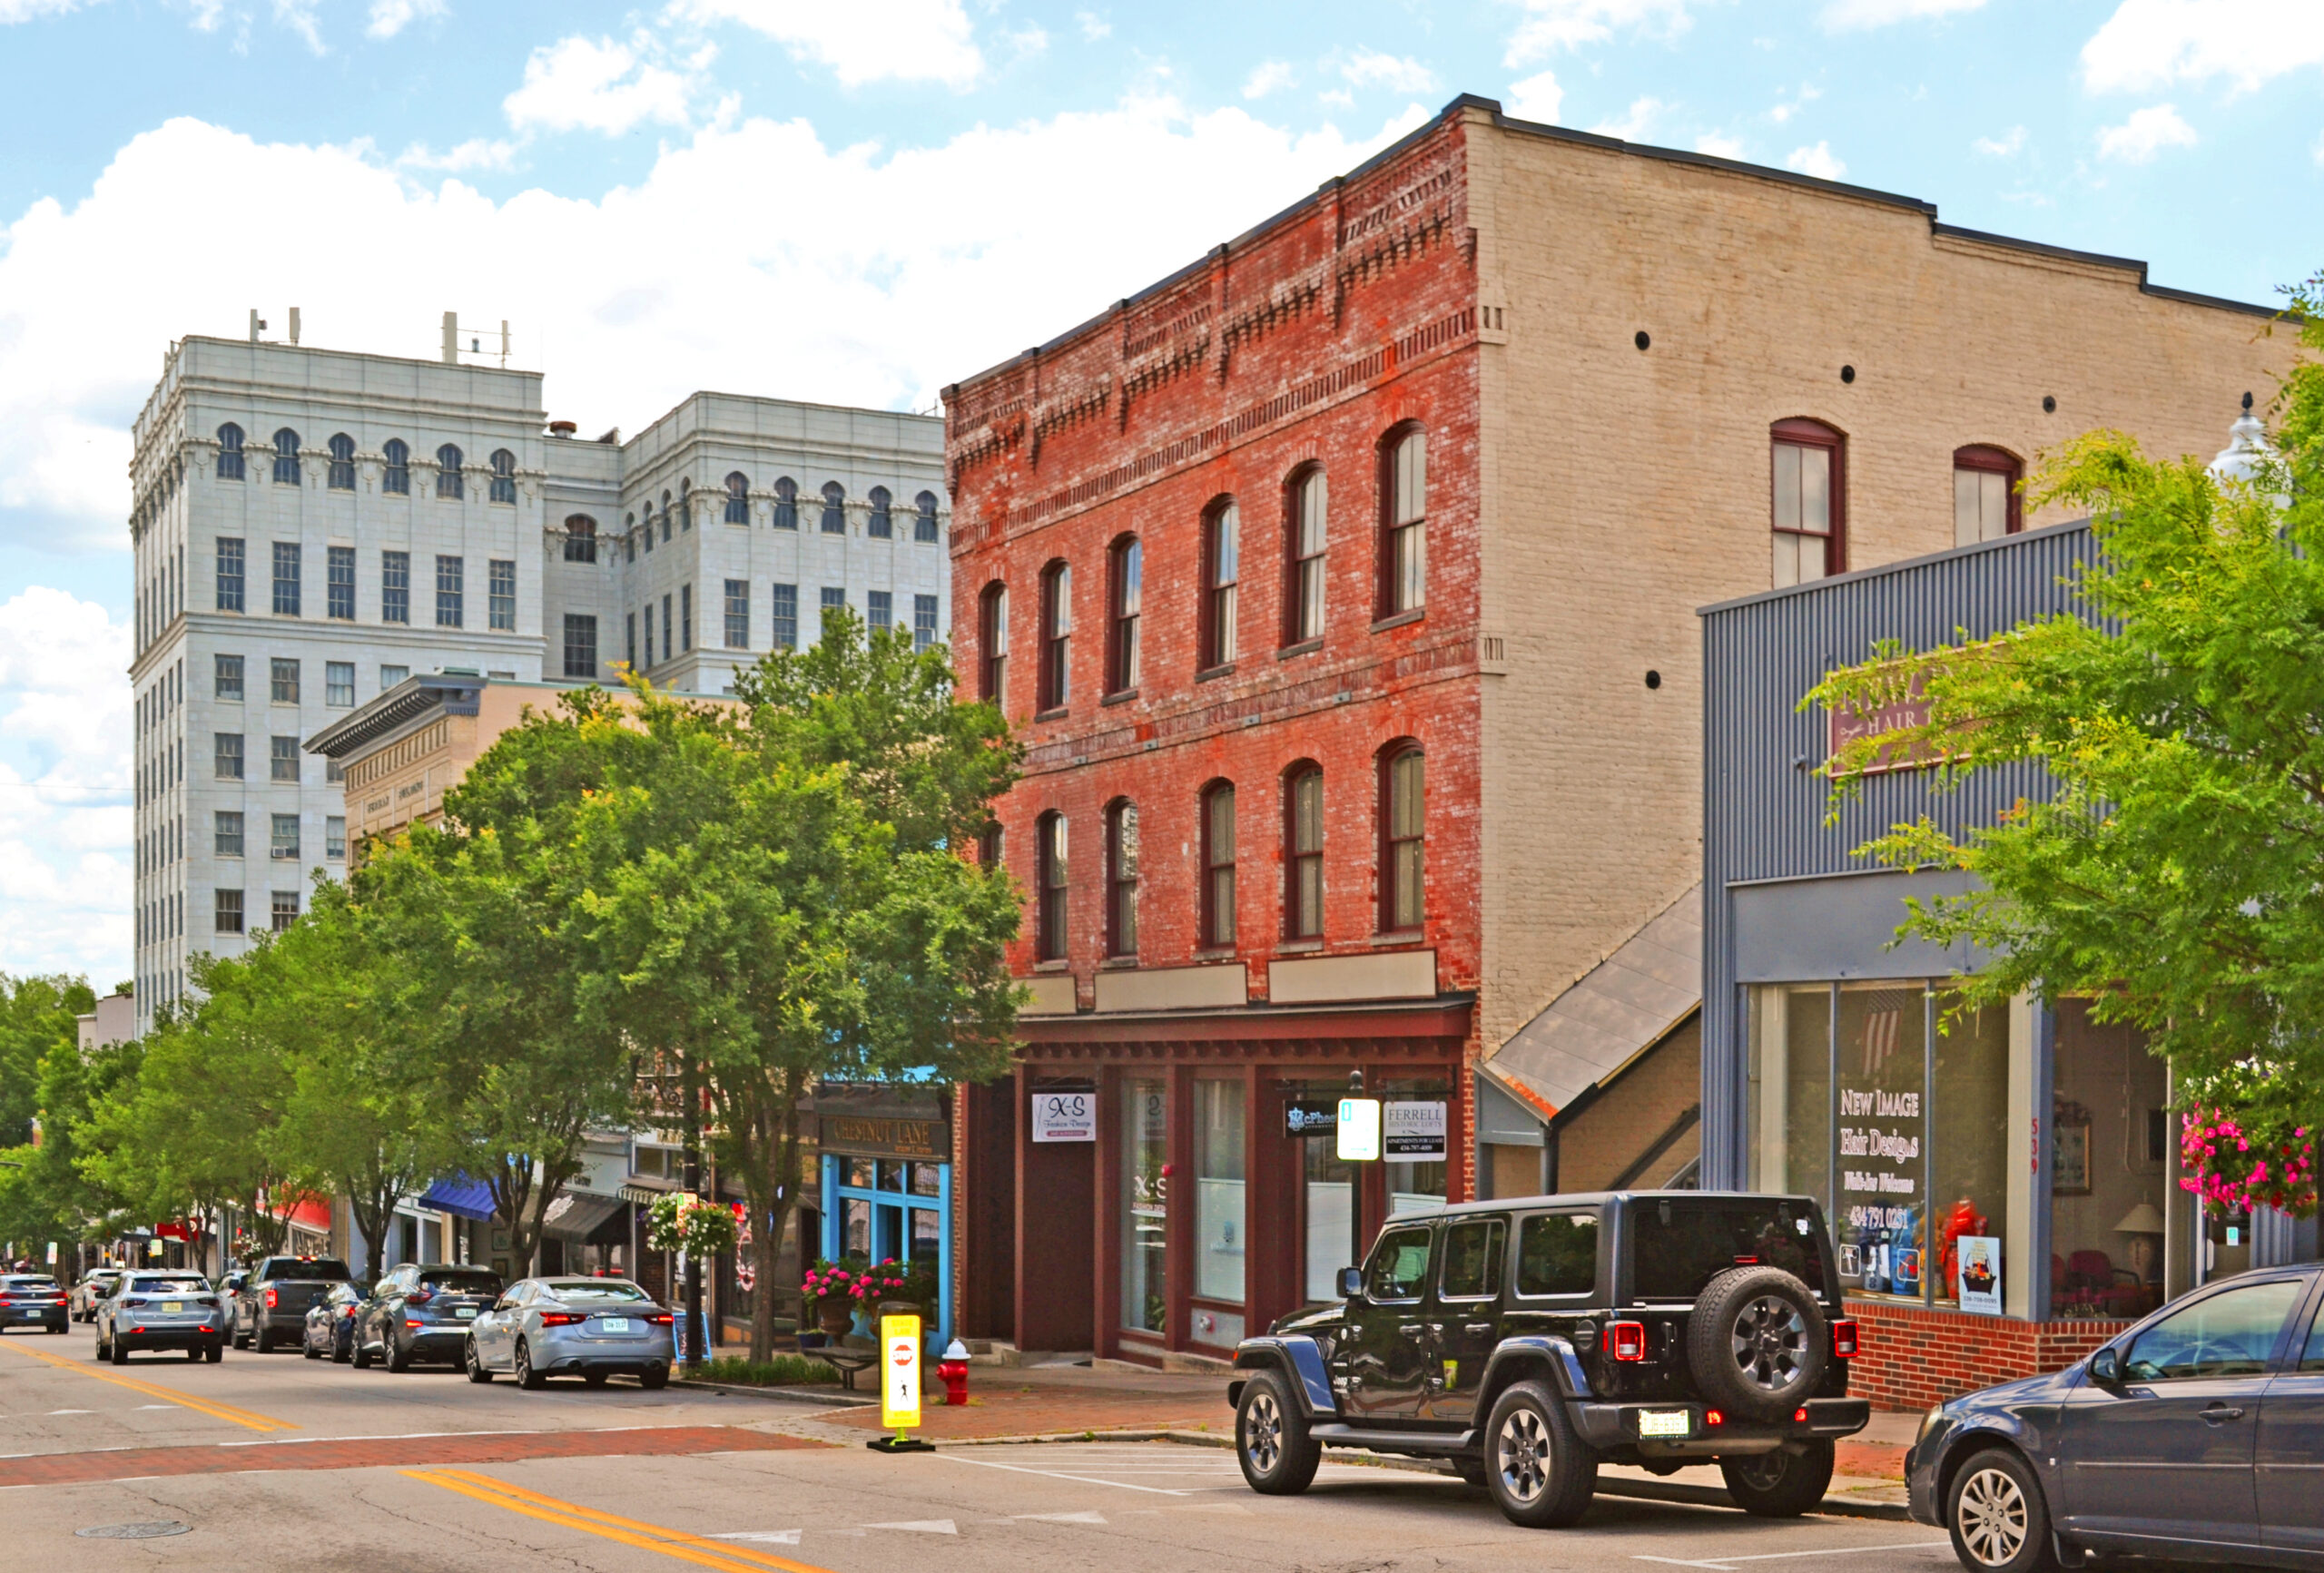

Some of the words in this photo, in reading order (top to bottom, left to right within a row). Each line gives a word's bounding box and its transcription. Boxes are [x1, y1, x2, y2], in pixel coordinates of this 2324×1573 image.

[1867, 711, 1915, 734] HAIR
[1049, 1096, 1085, 1118] X-S
[1388, 1109, 1443, 1120] FERRELL
[1840, 1089, 1873, 1116] NEW
[1876, 1089, 1919, 1117] IMAGE
[834, 1118, 891, 1143] CHESTNUT
[896, 1120, 930, 1145] LANE
[1840, 1127, 1868, 1155] Hair
[1869, 1127, 1919, 1165] Designs
[1844, 1171, 1877, 1192] Walk-Ins
[1878, 1173, 1915, 1194] Welcome
[1849, 1205, 1867, 1227] 434
[1867, 1206, 1885, 1230] 791
[1886, 1207, 1908, 1230] 0251
